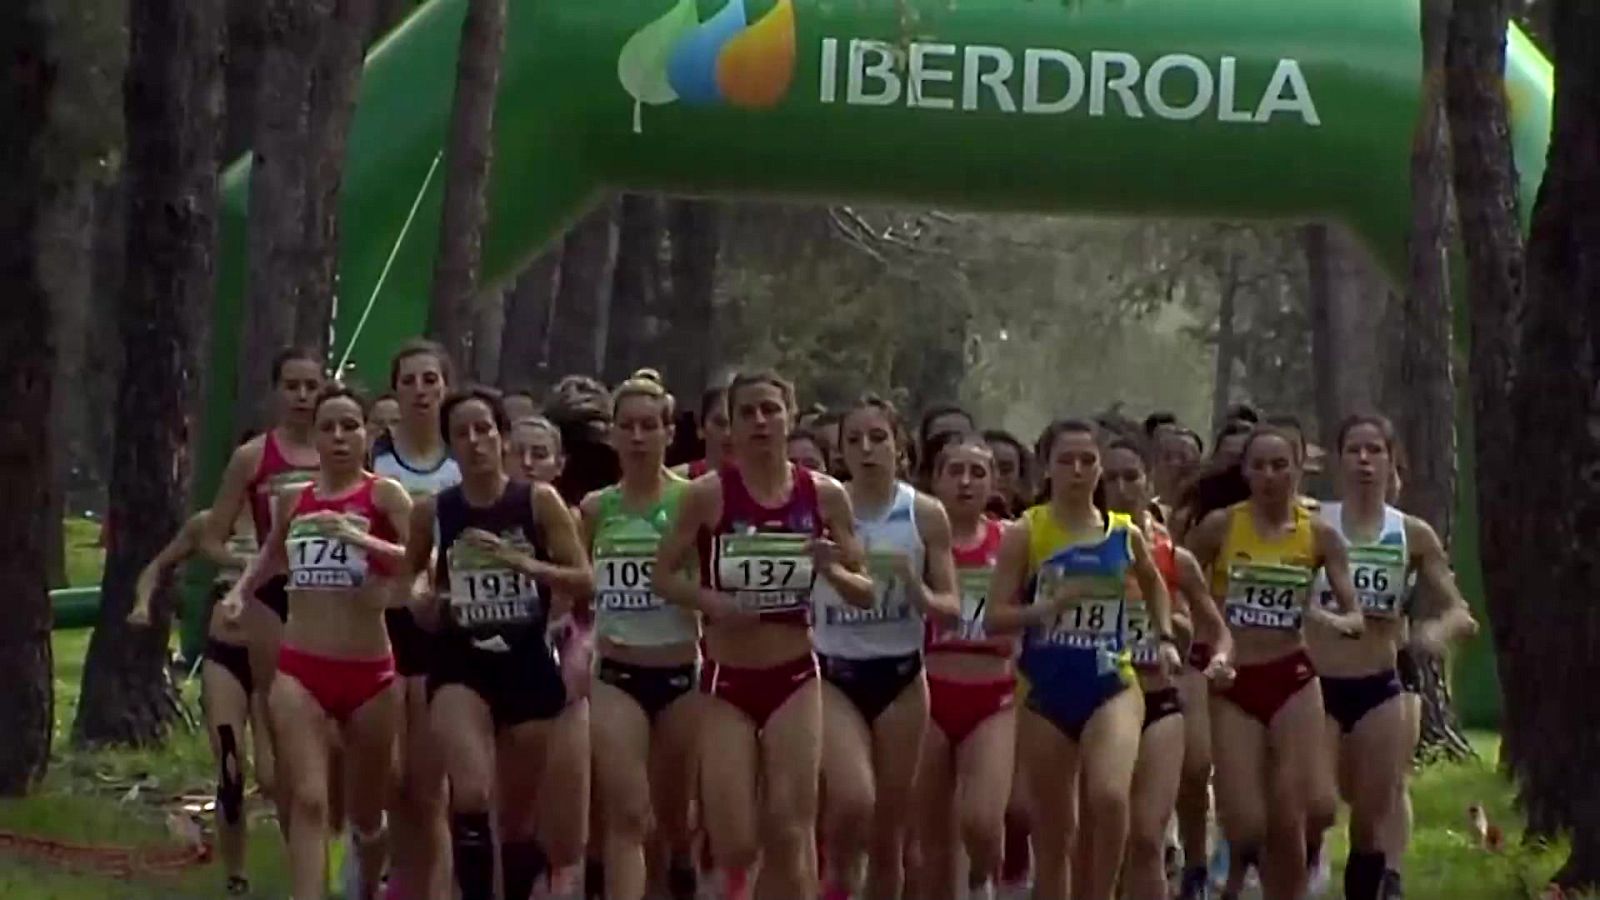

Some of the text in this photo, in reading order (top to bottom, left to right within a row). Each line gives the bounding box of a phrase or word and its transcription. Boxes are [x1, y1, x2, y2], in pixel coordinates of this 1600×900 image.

[819, 37, 1322, 126] IBERDROLA
[300, 540, 347, 565] 174
[738, 559, 797, 587] 137
[464, 574, 520, 600] 193
[1245, 586, 1294, 610] 184
